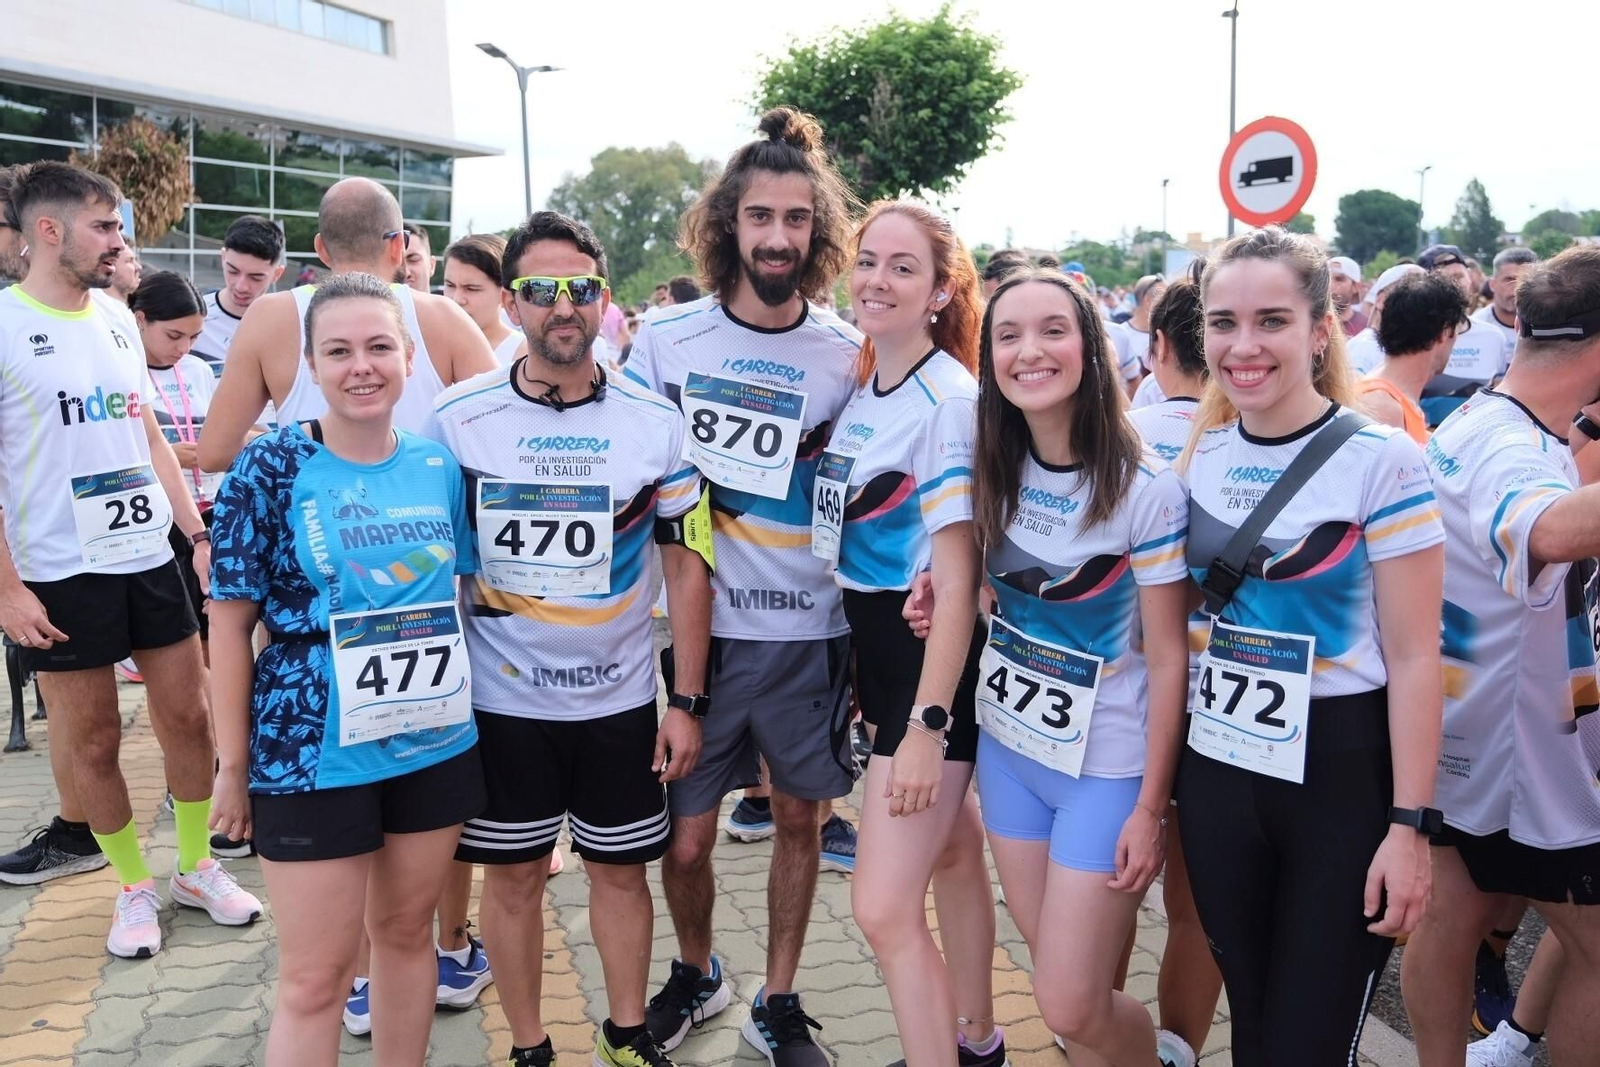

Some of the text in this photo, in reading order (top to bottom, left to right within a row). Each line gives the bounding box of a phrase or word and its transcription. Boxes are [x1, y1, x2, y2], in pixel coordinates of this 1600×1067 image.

[731, 359, 806, 382] CARRERA
[744, 393, 794, 409] INVESTIGACIÓN
[746, 387, 776, 399] CARRERA
[752, 401, 772, 411] SALUD
[692, 408, 782, 458] 870
[527, 436, 610, 453] CARRERA
[548, 455, 606, 464] INVESTIGACIÓN
[536, 465, 591, 476] EN SALUD
[1232, 466, 1283, 484] CARRE
[1020, 486, 1078, 514] CARRERA
[1220, 487, 1232, 496] POR
[1232, 488, 1240, 496] LA
[105, 494, 152, 530] 28
[818, 486, 840, 526] 469
[1227, 497, 1242, 509] EN
[1012, 513, 1052, 536] EN SALUD
[1027, 508, 1067, 527] INVESTIGACIÓN
[339, 521, 454, 550] MAPACHE
[494, 520, 595, 558] 470
[728, 588, 815, 610] IMIBIC
[376, 624, 392, 632] POR
[402, 616, 451, 630] INVESTIGACIÓN
[400, 612, 432, 622] CARRERA
[410, 627, 433, 636] SALUD
[1234, 634, 1272, 648] CARRERA
[1032, 646, 1066, 662] CARRERA
[1225, 641, 1234, 649] LA
[1234, 643, 1298, 660] INVESTIGACIÓN
[1233, 651, 1269, 664] EN SALUD
[1012, 644, 1088, 676] POR LA INVESTIGACIÓN
[1028, 660, 1062, 676] EN SALUD
[356, 645, 452, 696] 477
[532, 662, 622, 688] IMIBIC
[986, 666, 1072, 729] 473
[1200, 666, 1286, 728] 472
